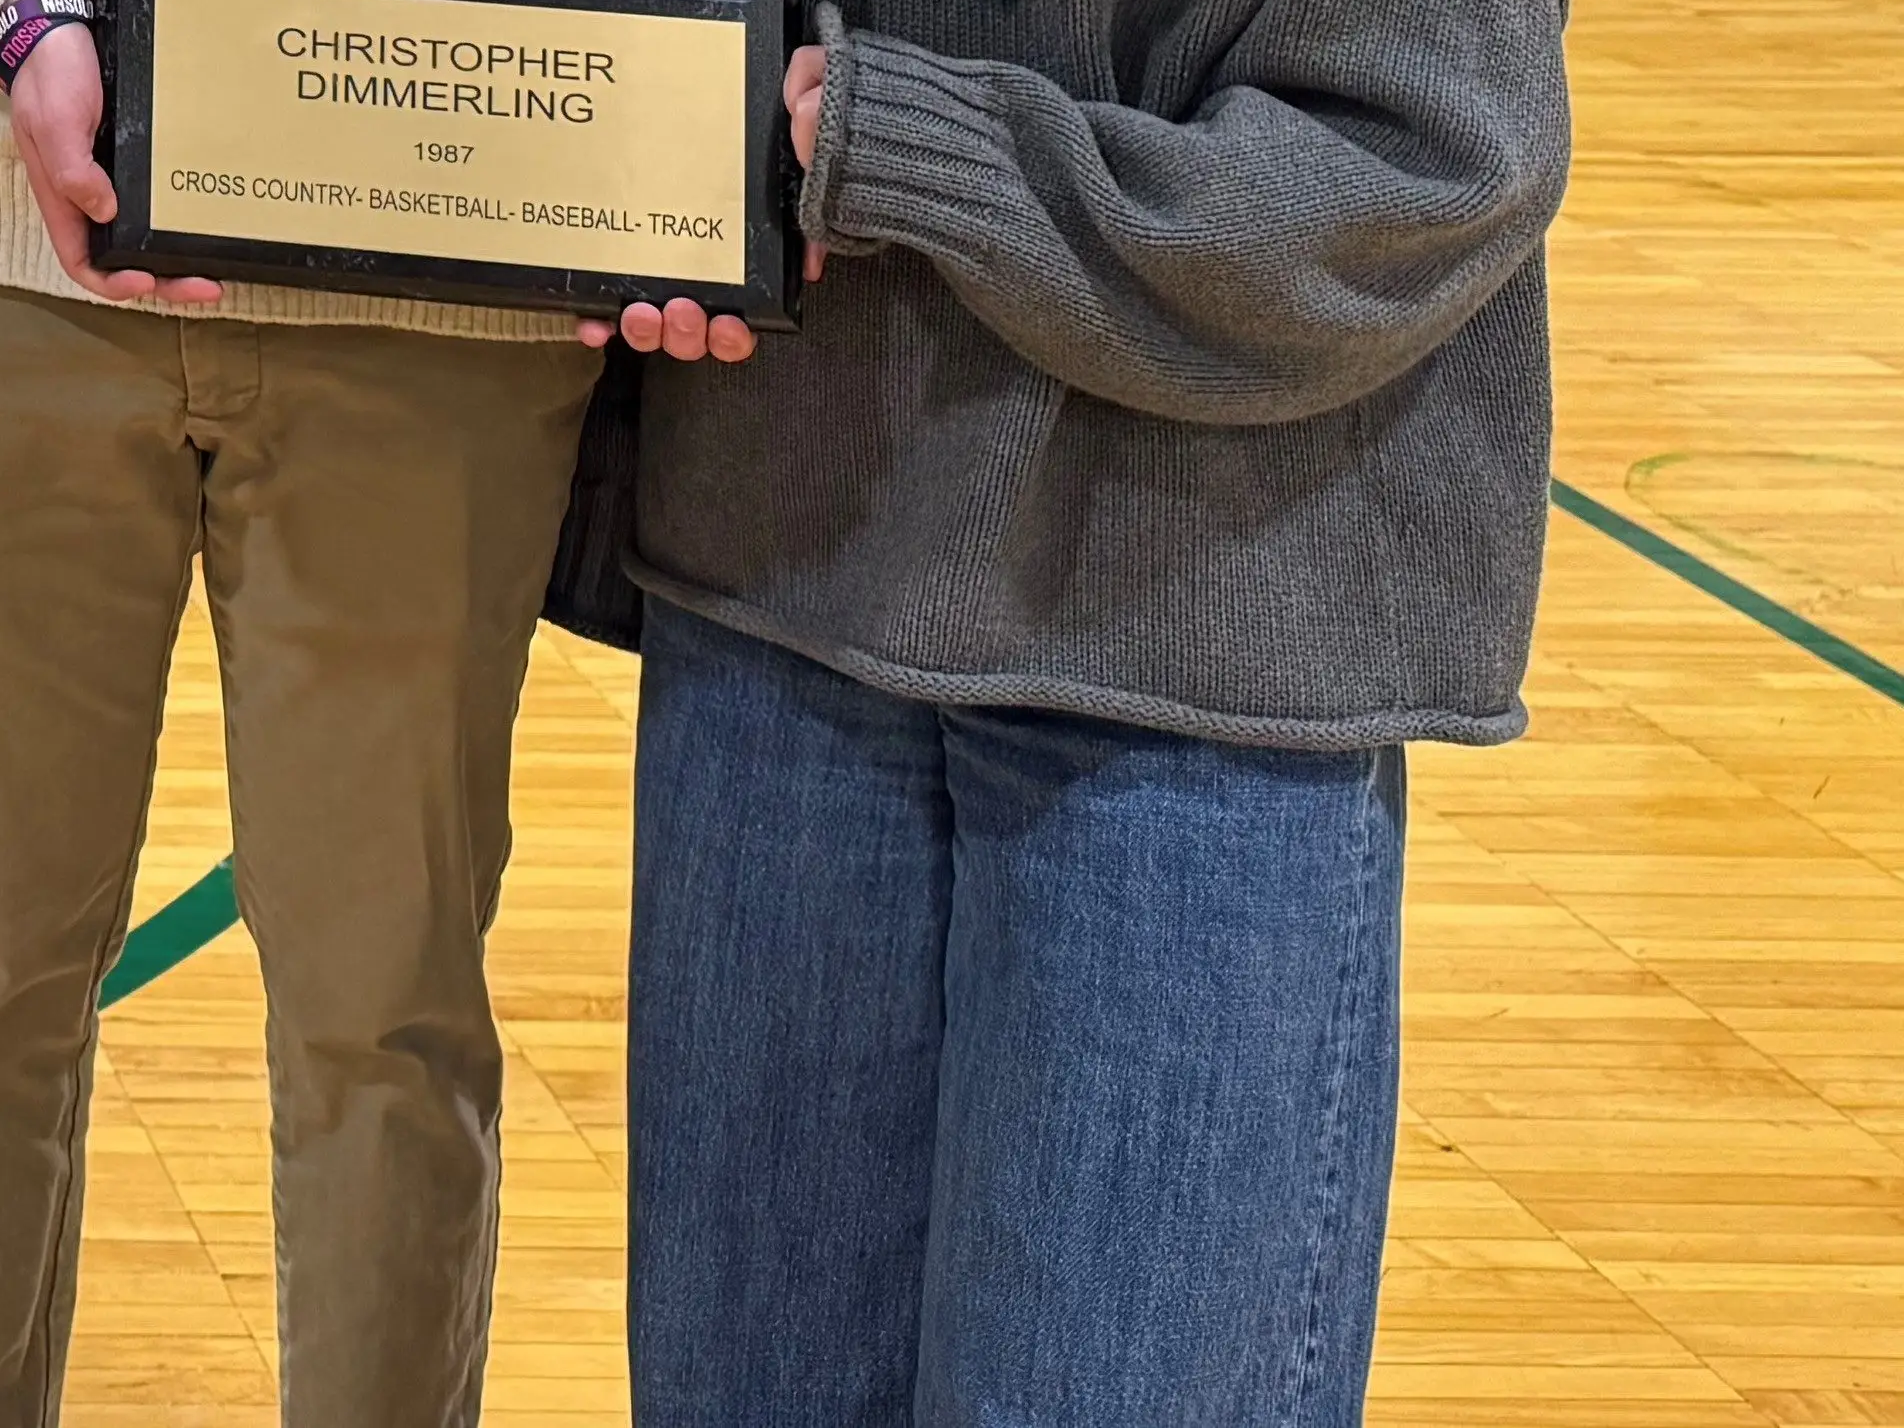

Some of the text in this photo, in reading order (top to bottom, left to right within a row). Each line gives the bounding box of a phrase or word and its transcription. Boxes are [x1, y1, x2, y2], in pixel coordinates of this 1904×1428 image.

[277, 28, 616, 83] CHRISTOPHER
[298, 70, 593, 123] DIMMERLING
[414, 142, 474, 164] 1987
[171, 170, 724, 241] CROSS COUNTRY- BASKETBALL- BASEBALL- TRACK
